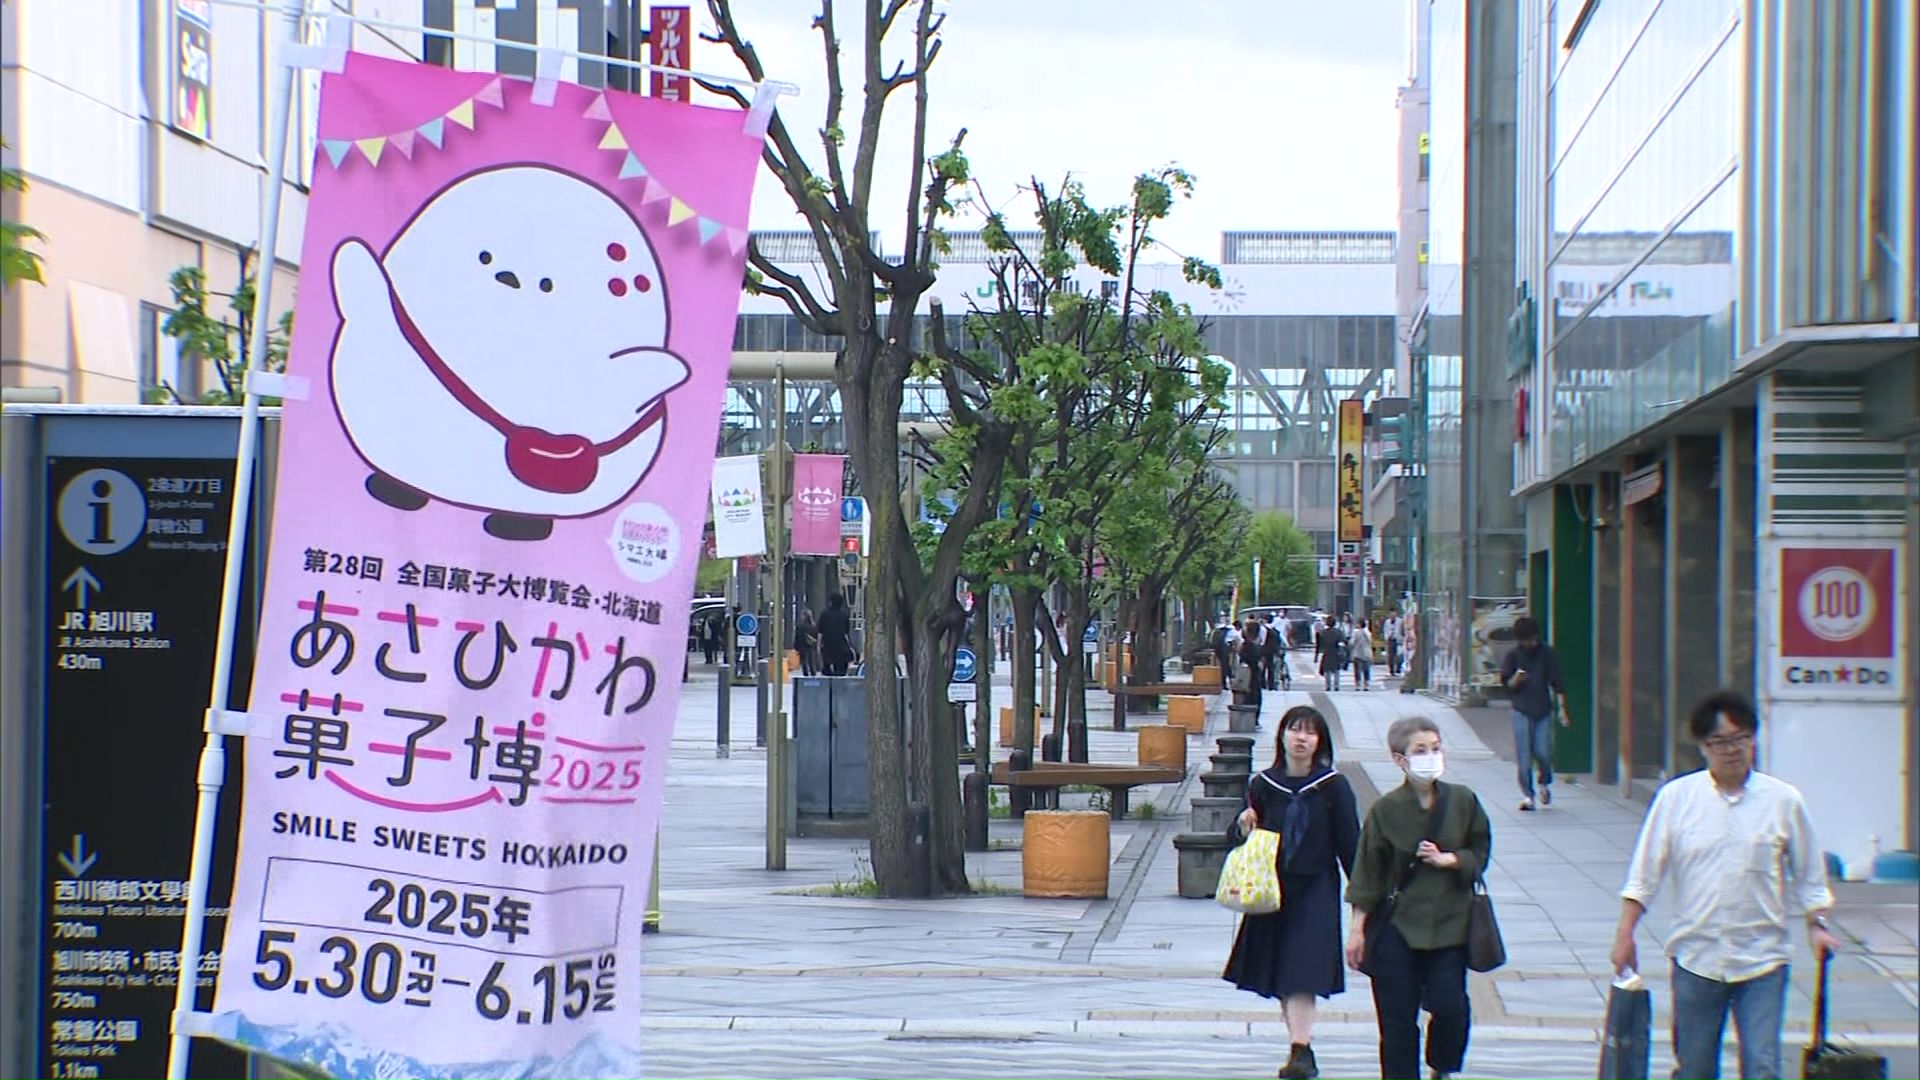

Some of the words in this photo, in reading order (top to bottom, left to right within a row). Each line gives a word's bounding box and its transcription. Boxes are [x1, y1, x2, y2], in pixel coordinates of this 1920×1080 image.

[304, 548, 383, 581] 第28回
[397, 561, 663, 626] 全国菓子大博覧会・北海道
[1813, 581, 1861, 618] 100
[59, 612, 85, 630] JR
[89, 611, 153, 632] 旭川駅
[133, 636, 170, 648] Station
[58, 654, 102, 670] 430m
[290, 590, 659, 718] あさひかわ
[272, 689, 546, 808] 菓子博
[544, 753, 643, 792] 2025
[272, 811, 357, 843] SMILE
[373, 825, 487, 861] SWEETS
[502, 841, 629, 868] HOKKAIDO
[53, 922, 97, 938] 700m
[364, 878, 532, 944] 2025年
[52, 992, 96, 1008] 750m
[252, 929, 403, 1004] 5.30
[404, 950, 436, 1007] FRI
[475, 958, 594, 1024] 6.15
[592, 952, 615, 1012] SUN
